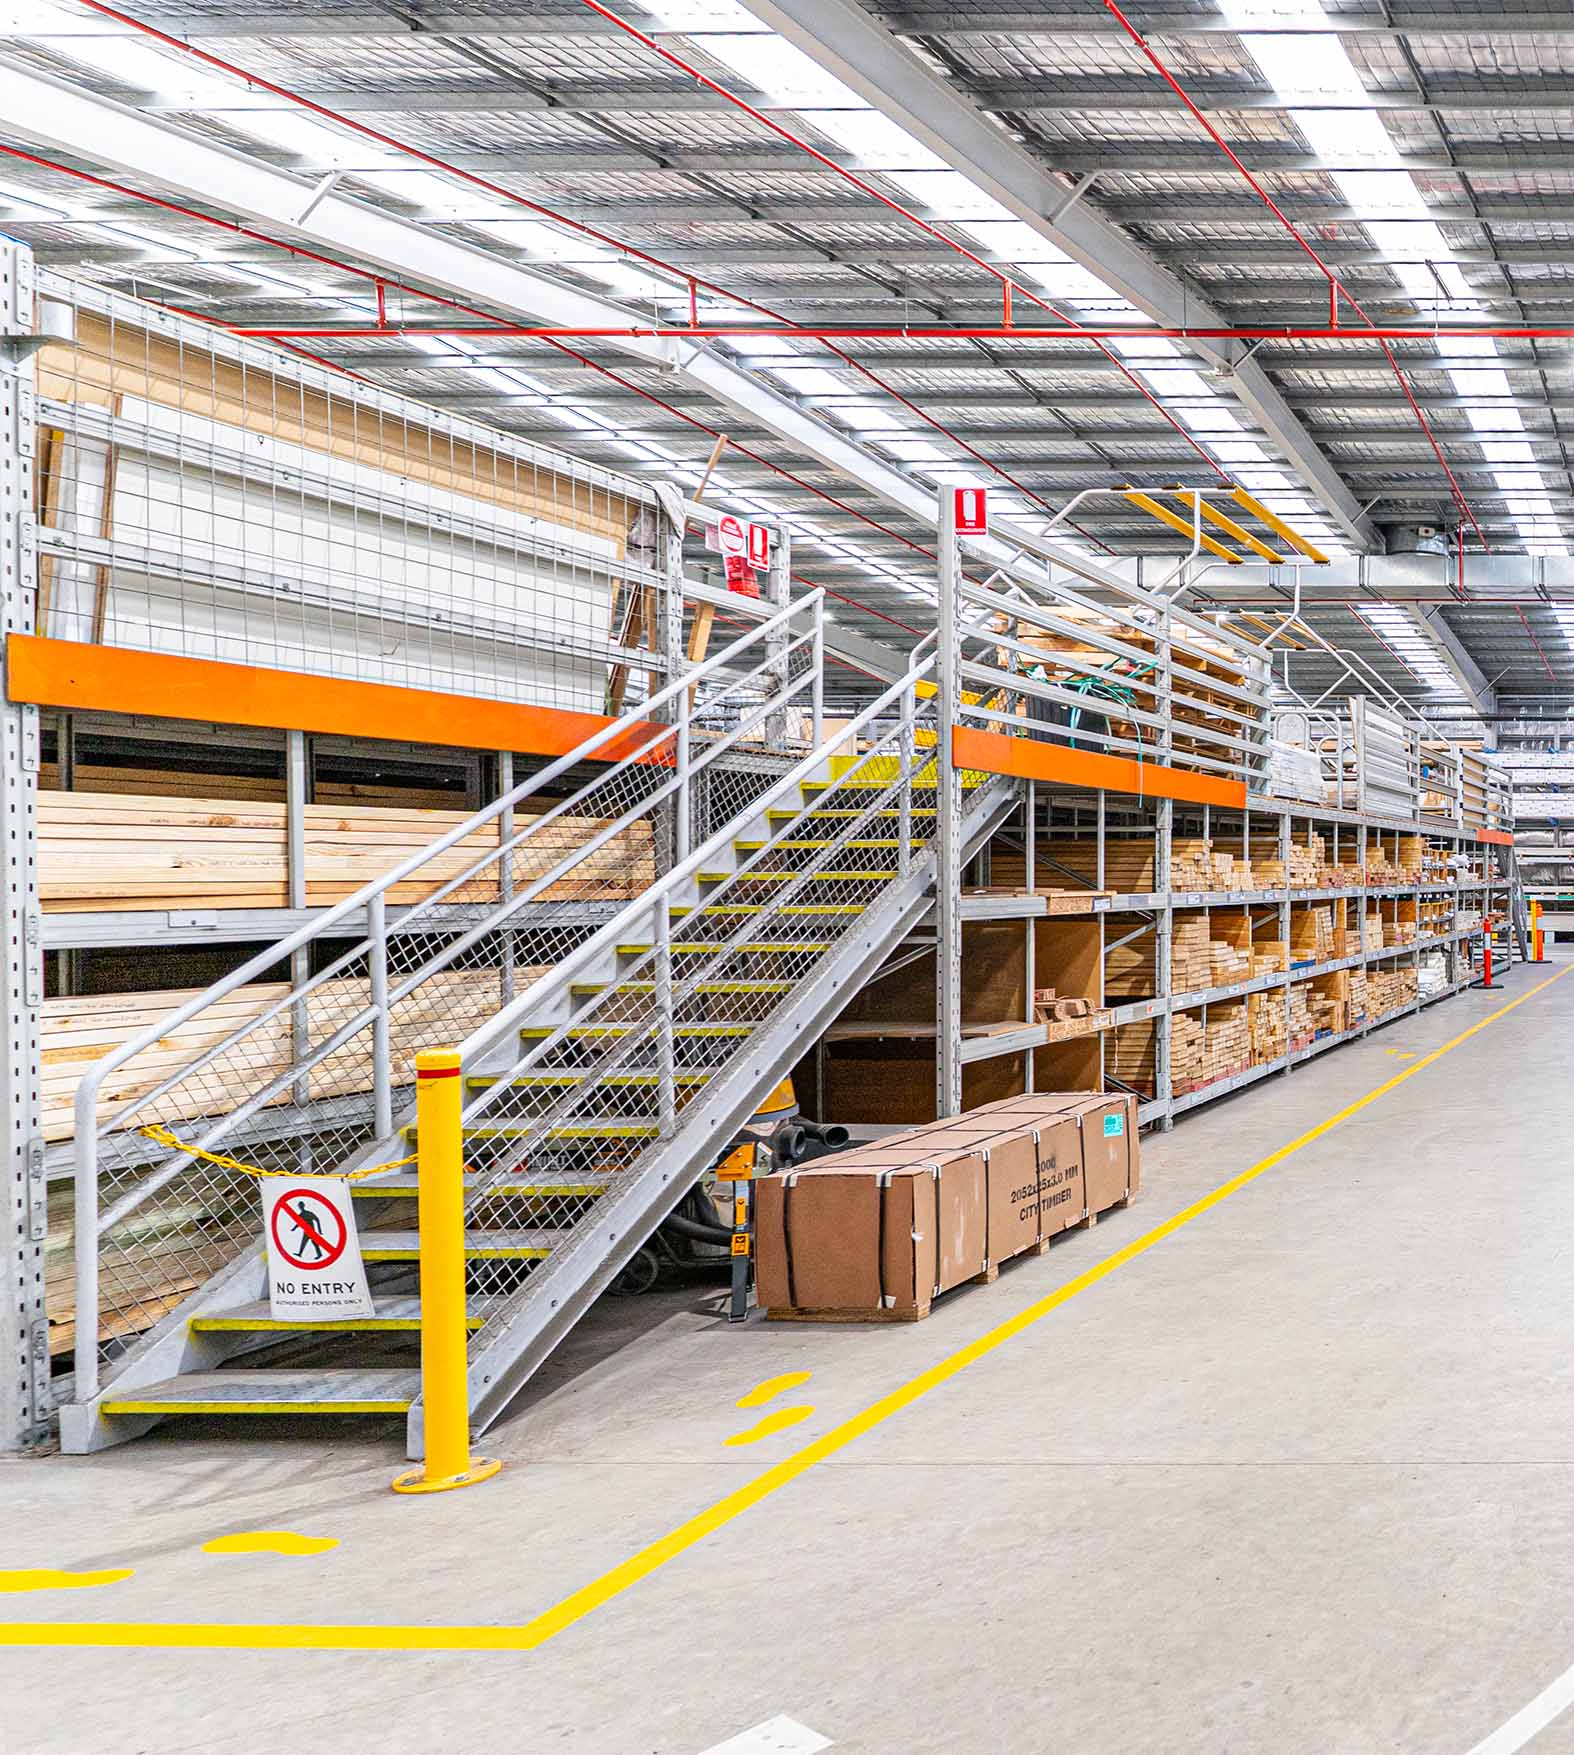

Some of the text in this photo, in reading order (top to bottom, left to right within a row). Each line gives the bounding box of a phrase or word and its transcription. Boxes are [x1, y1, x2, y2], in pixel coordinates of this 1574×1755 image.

[1042, 1188, 1072, 1212] TIMBER
[277, 1282, 356, 1295] NO ENTRY
